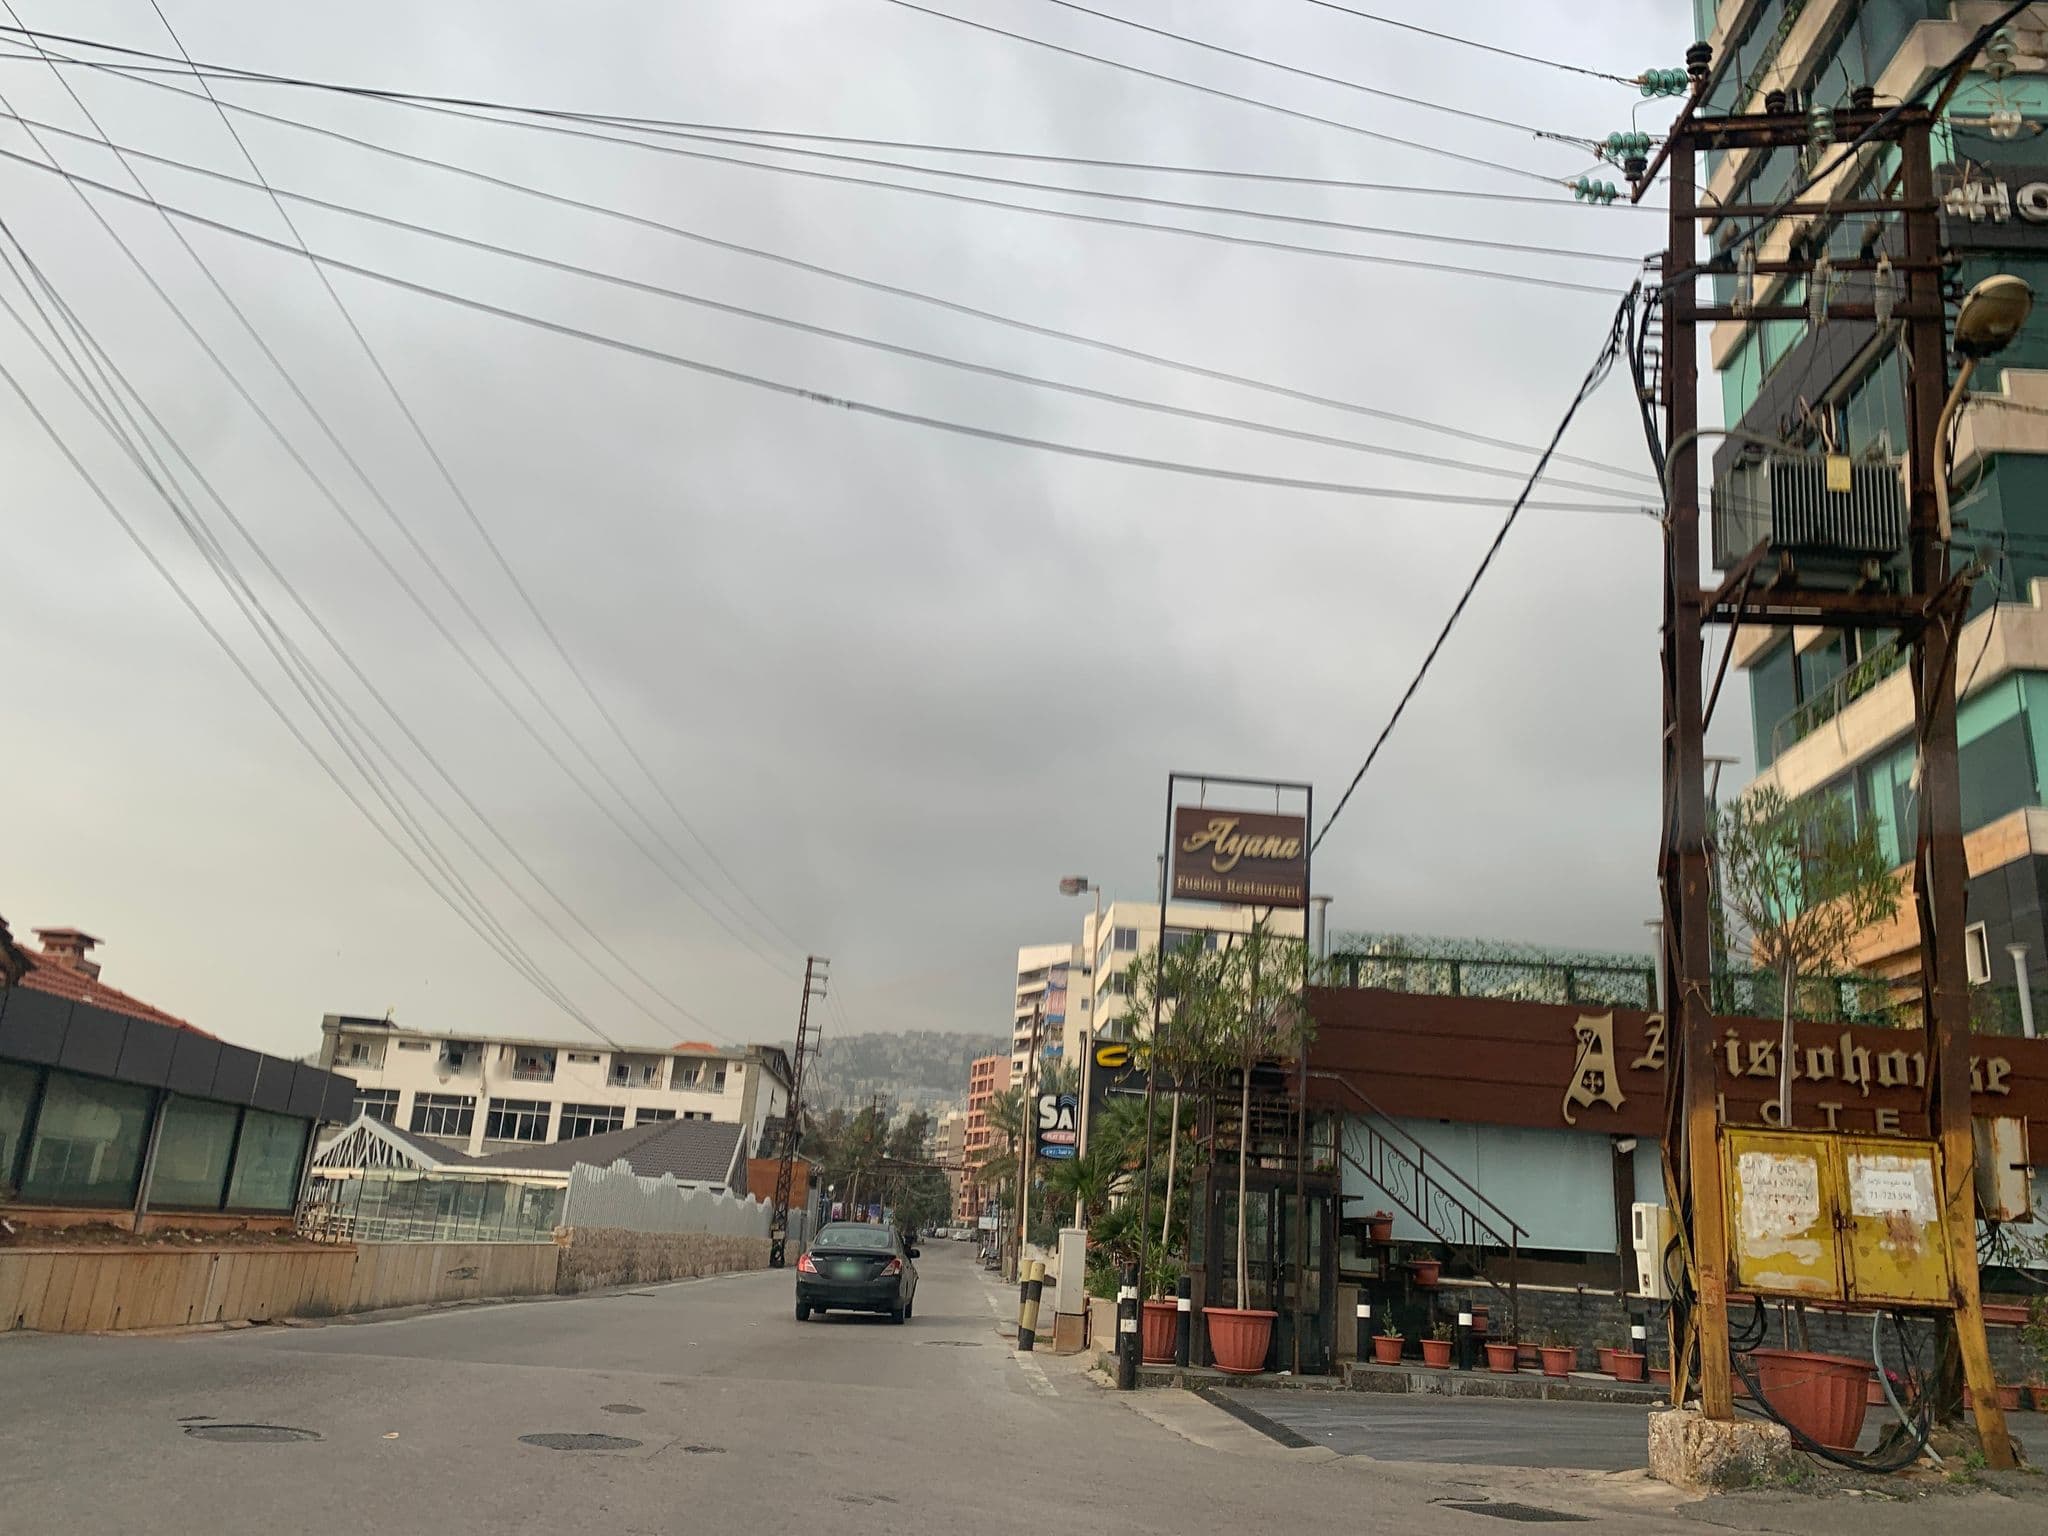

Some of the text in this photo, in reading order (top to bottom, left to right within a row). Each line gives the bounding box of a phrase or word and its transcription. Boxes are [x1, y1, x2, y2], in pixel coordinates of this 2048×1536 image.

[1183, 817, 1300, 873] Ayana
[1177, 875, 1301, 899] Fusion Restaurant
[1039, 1095, 1077, 1130] SA
[1714, 1092, 1900, 1135] OTE
